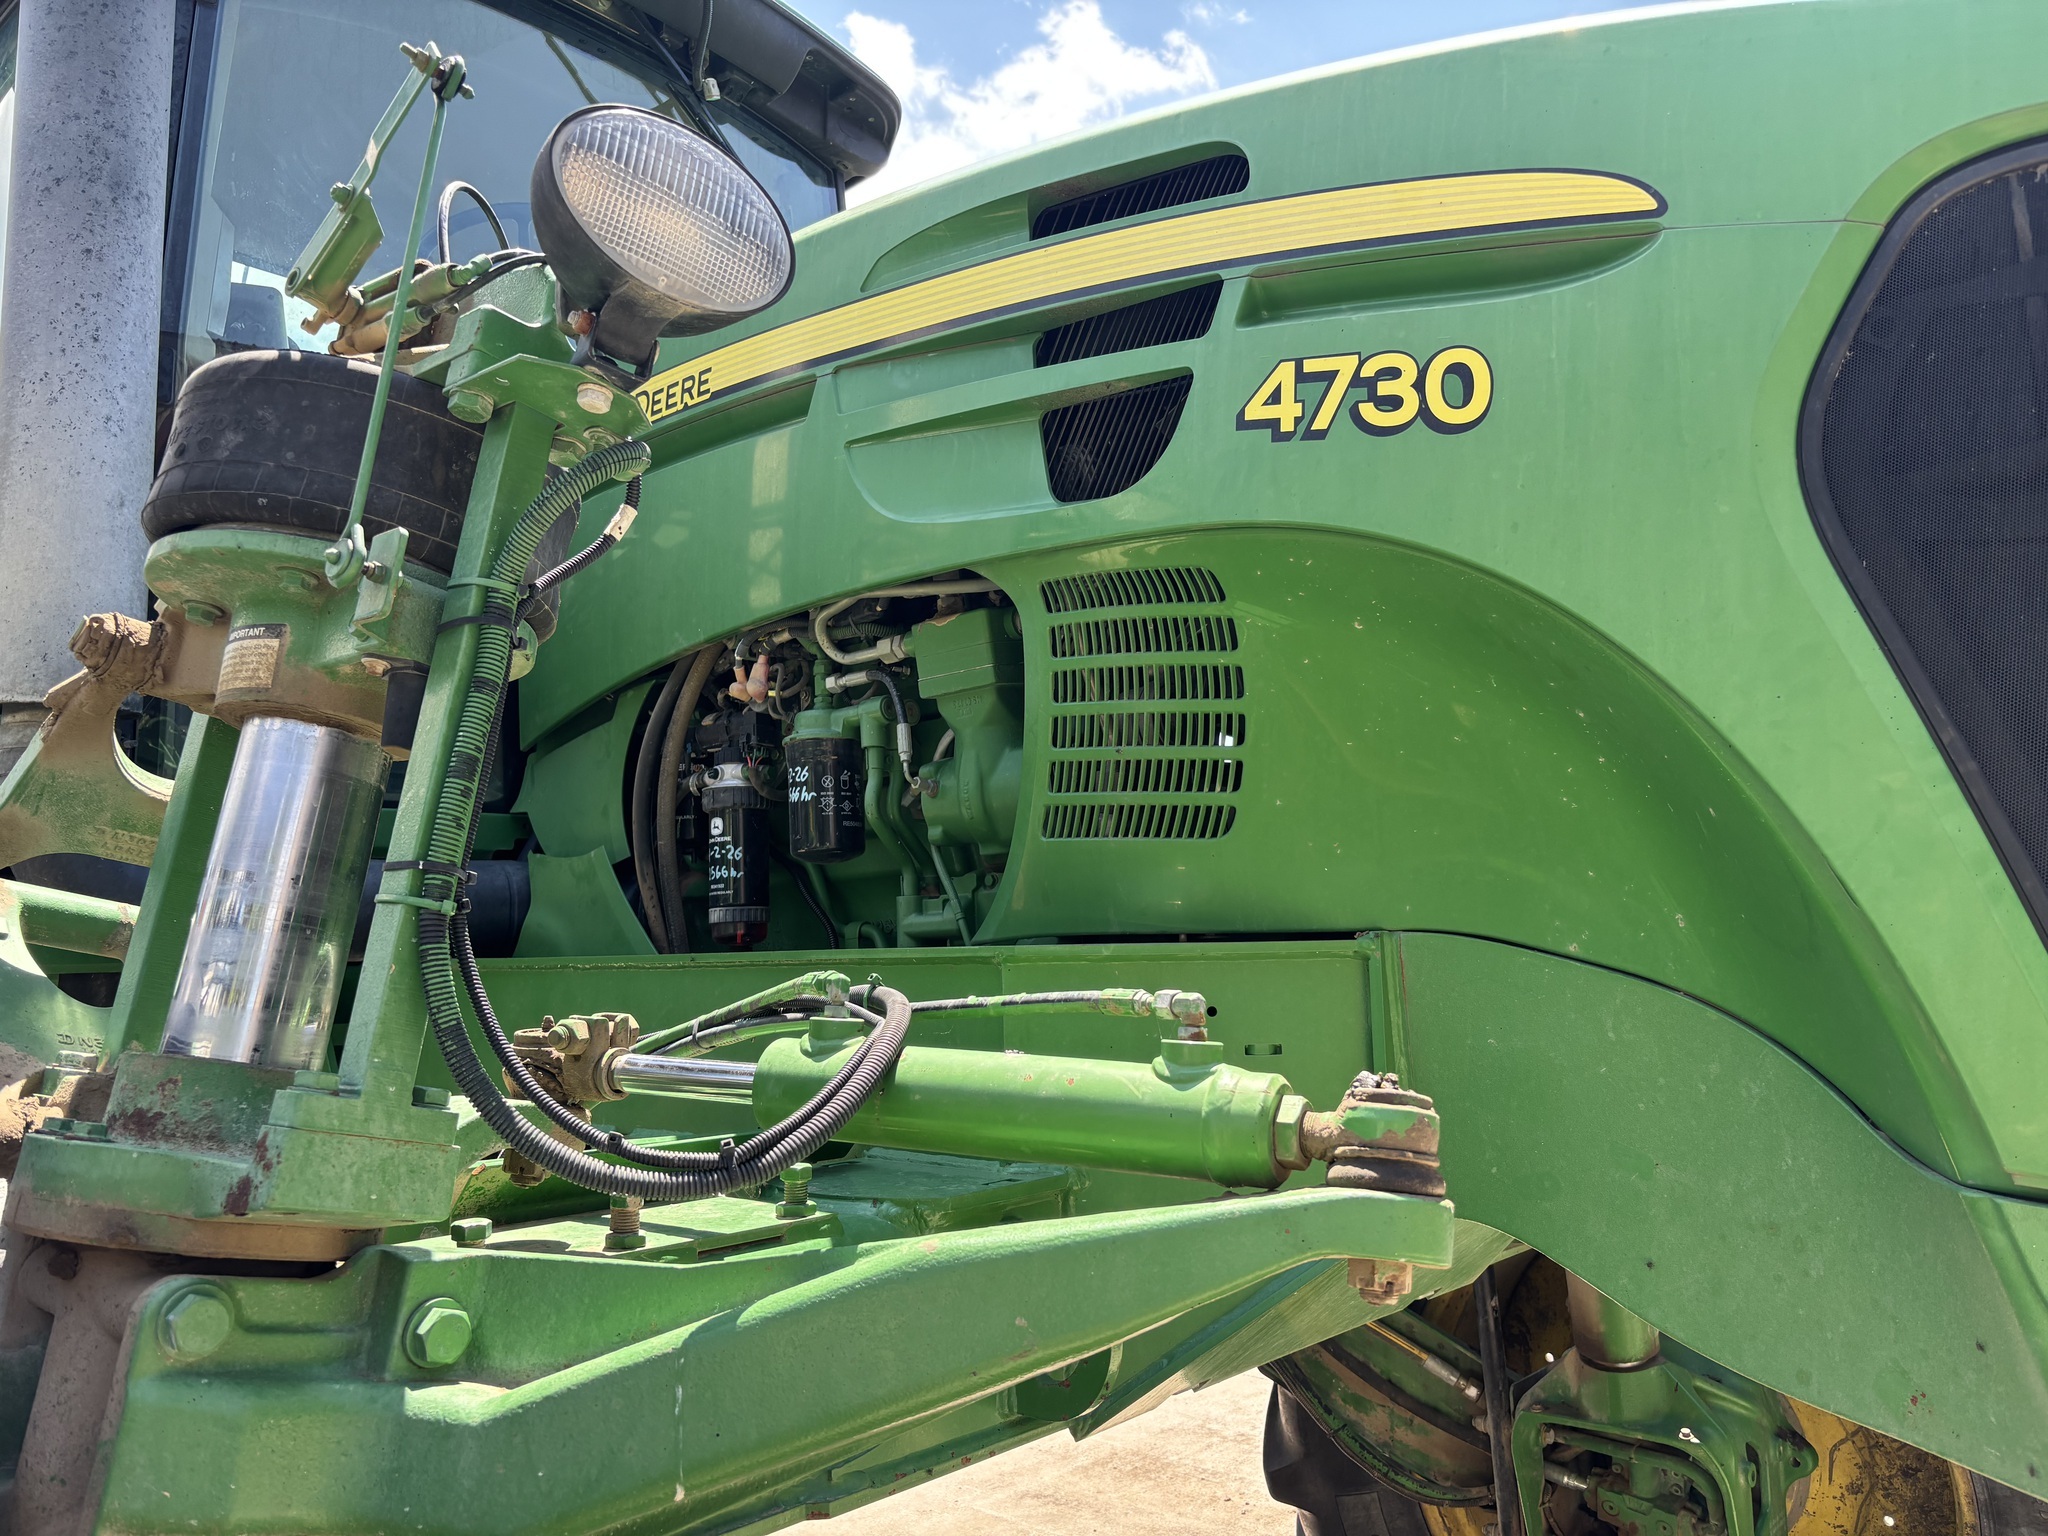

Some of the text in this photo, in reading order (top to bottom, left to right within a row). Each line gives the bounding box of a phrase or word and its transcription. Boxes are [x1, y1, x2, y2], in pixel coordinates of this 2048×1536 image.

[636, 367, 712, 417] DEERE
[1236, 345, 1494, 442] 4730
[801, 785, 817, 802] hr
